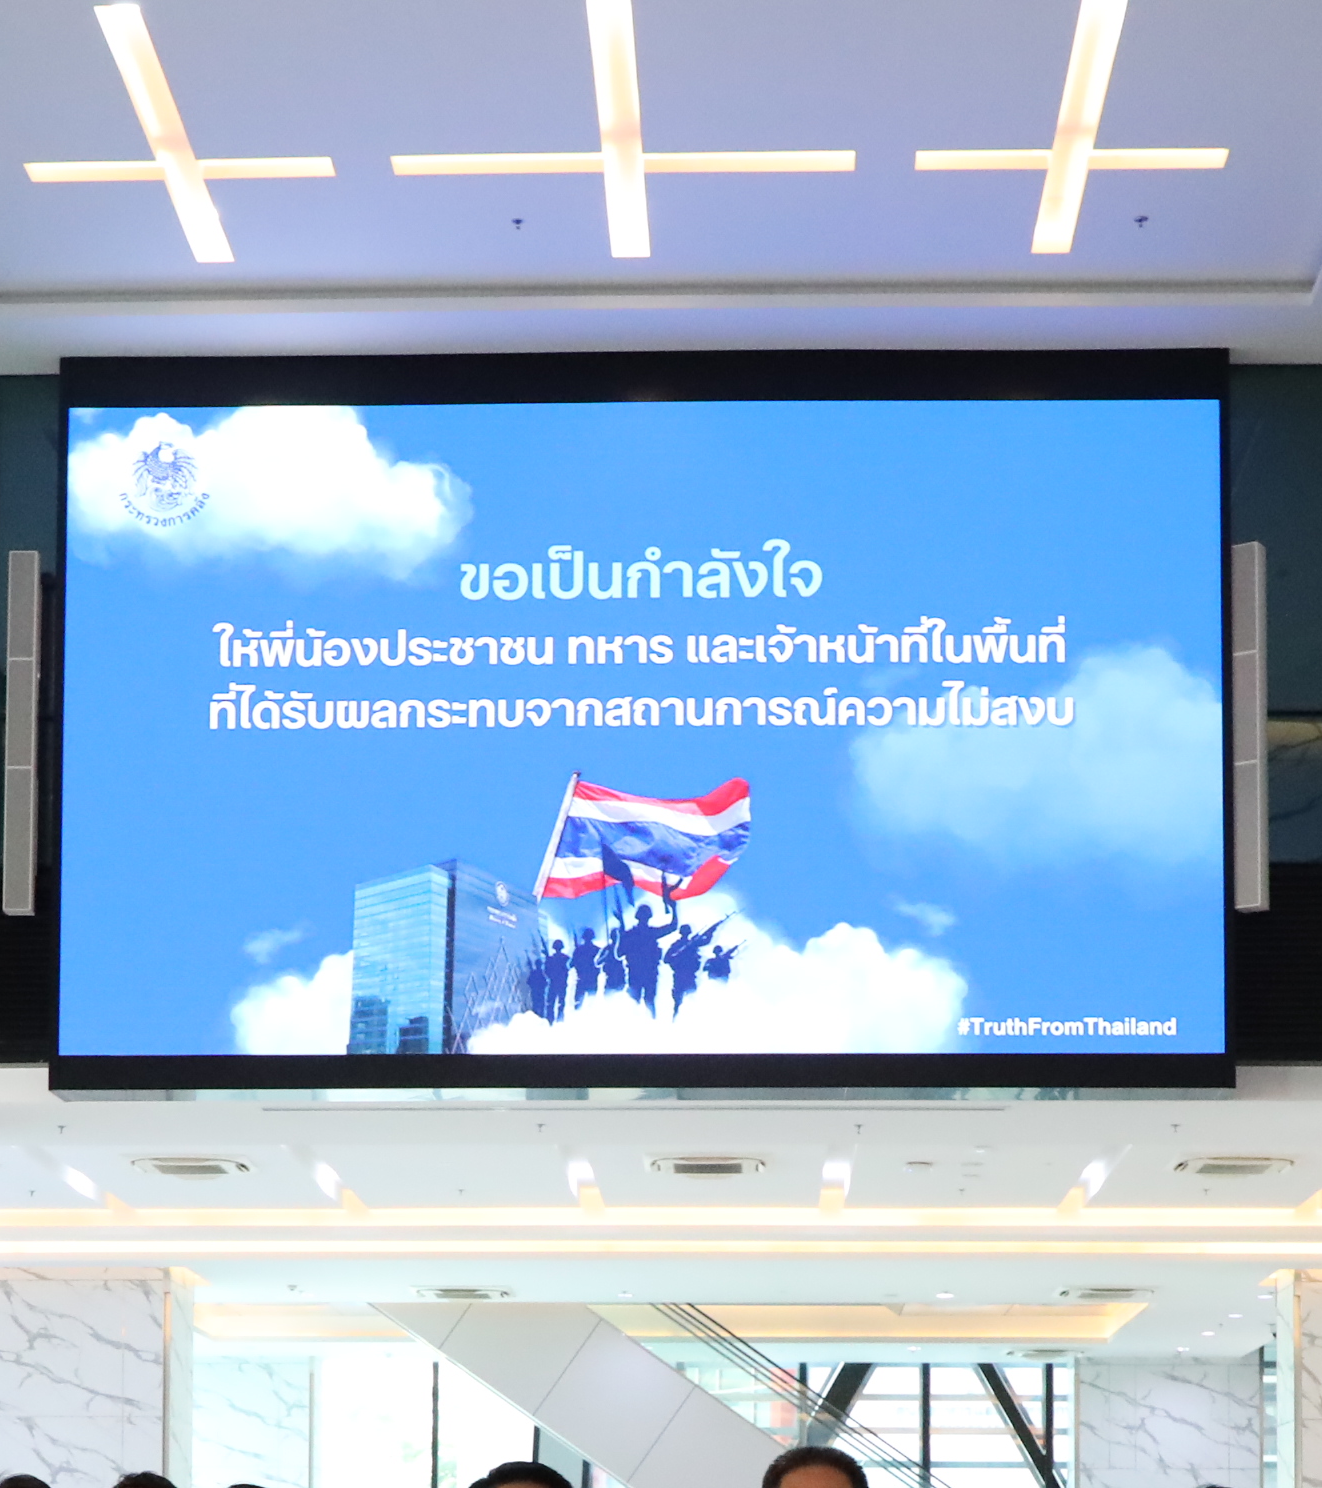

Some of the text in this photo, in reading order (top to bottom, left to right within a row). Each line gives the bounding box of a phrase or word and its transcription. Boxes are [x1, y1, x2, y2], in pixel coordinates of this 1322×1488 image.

[459, 539, 823, 603] ขอเป็นกำลังใจ
[213, 616, 1066, 669] ให้พี่น้องประชาชน ทหาร และเจ้าหน้าที่ในพื้นที่
[209, 682, 1075, 732] ที่ได้รับผลกระทบจากสถานการณ์ความไม่สงบ
[958, 1016, 1177, 1040] #TruthFromThailand
